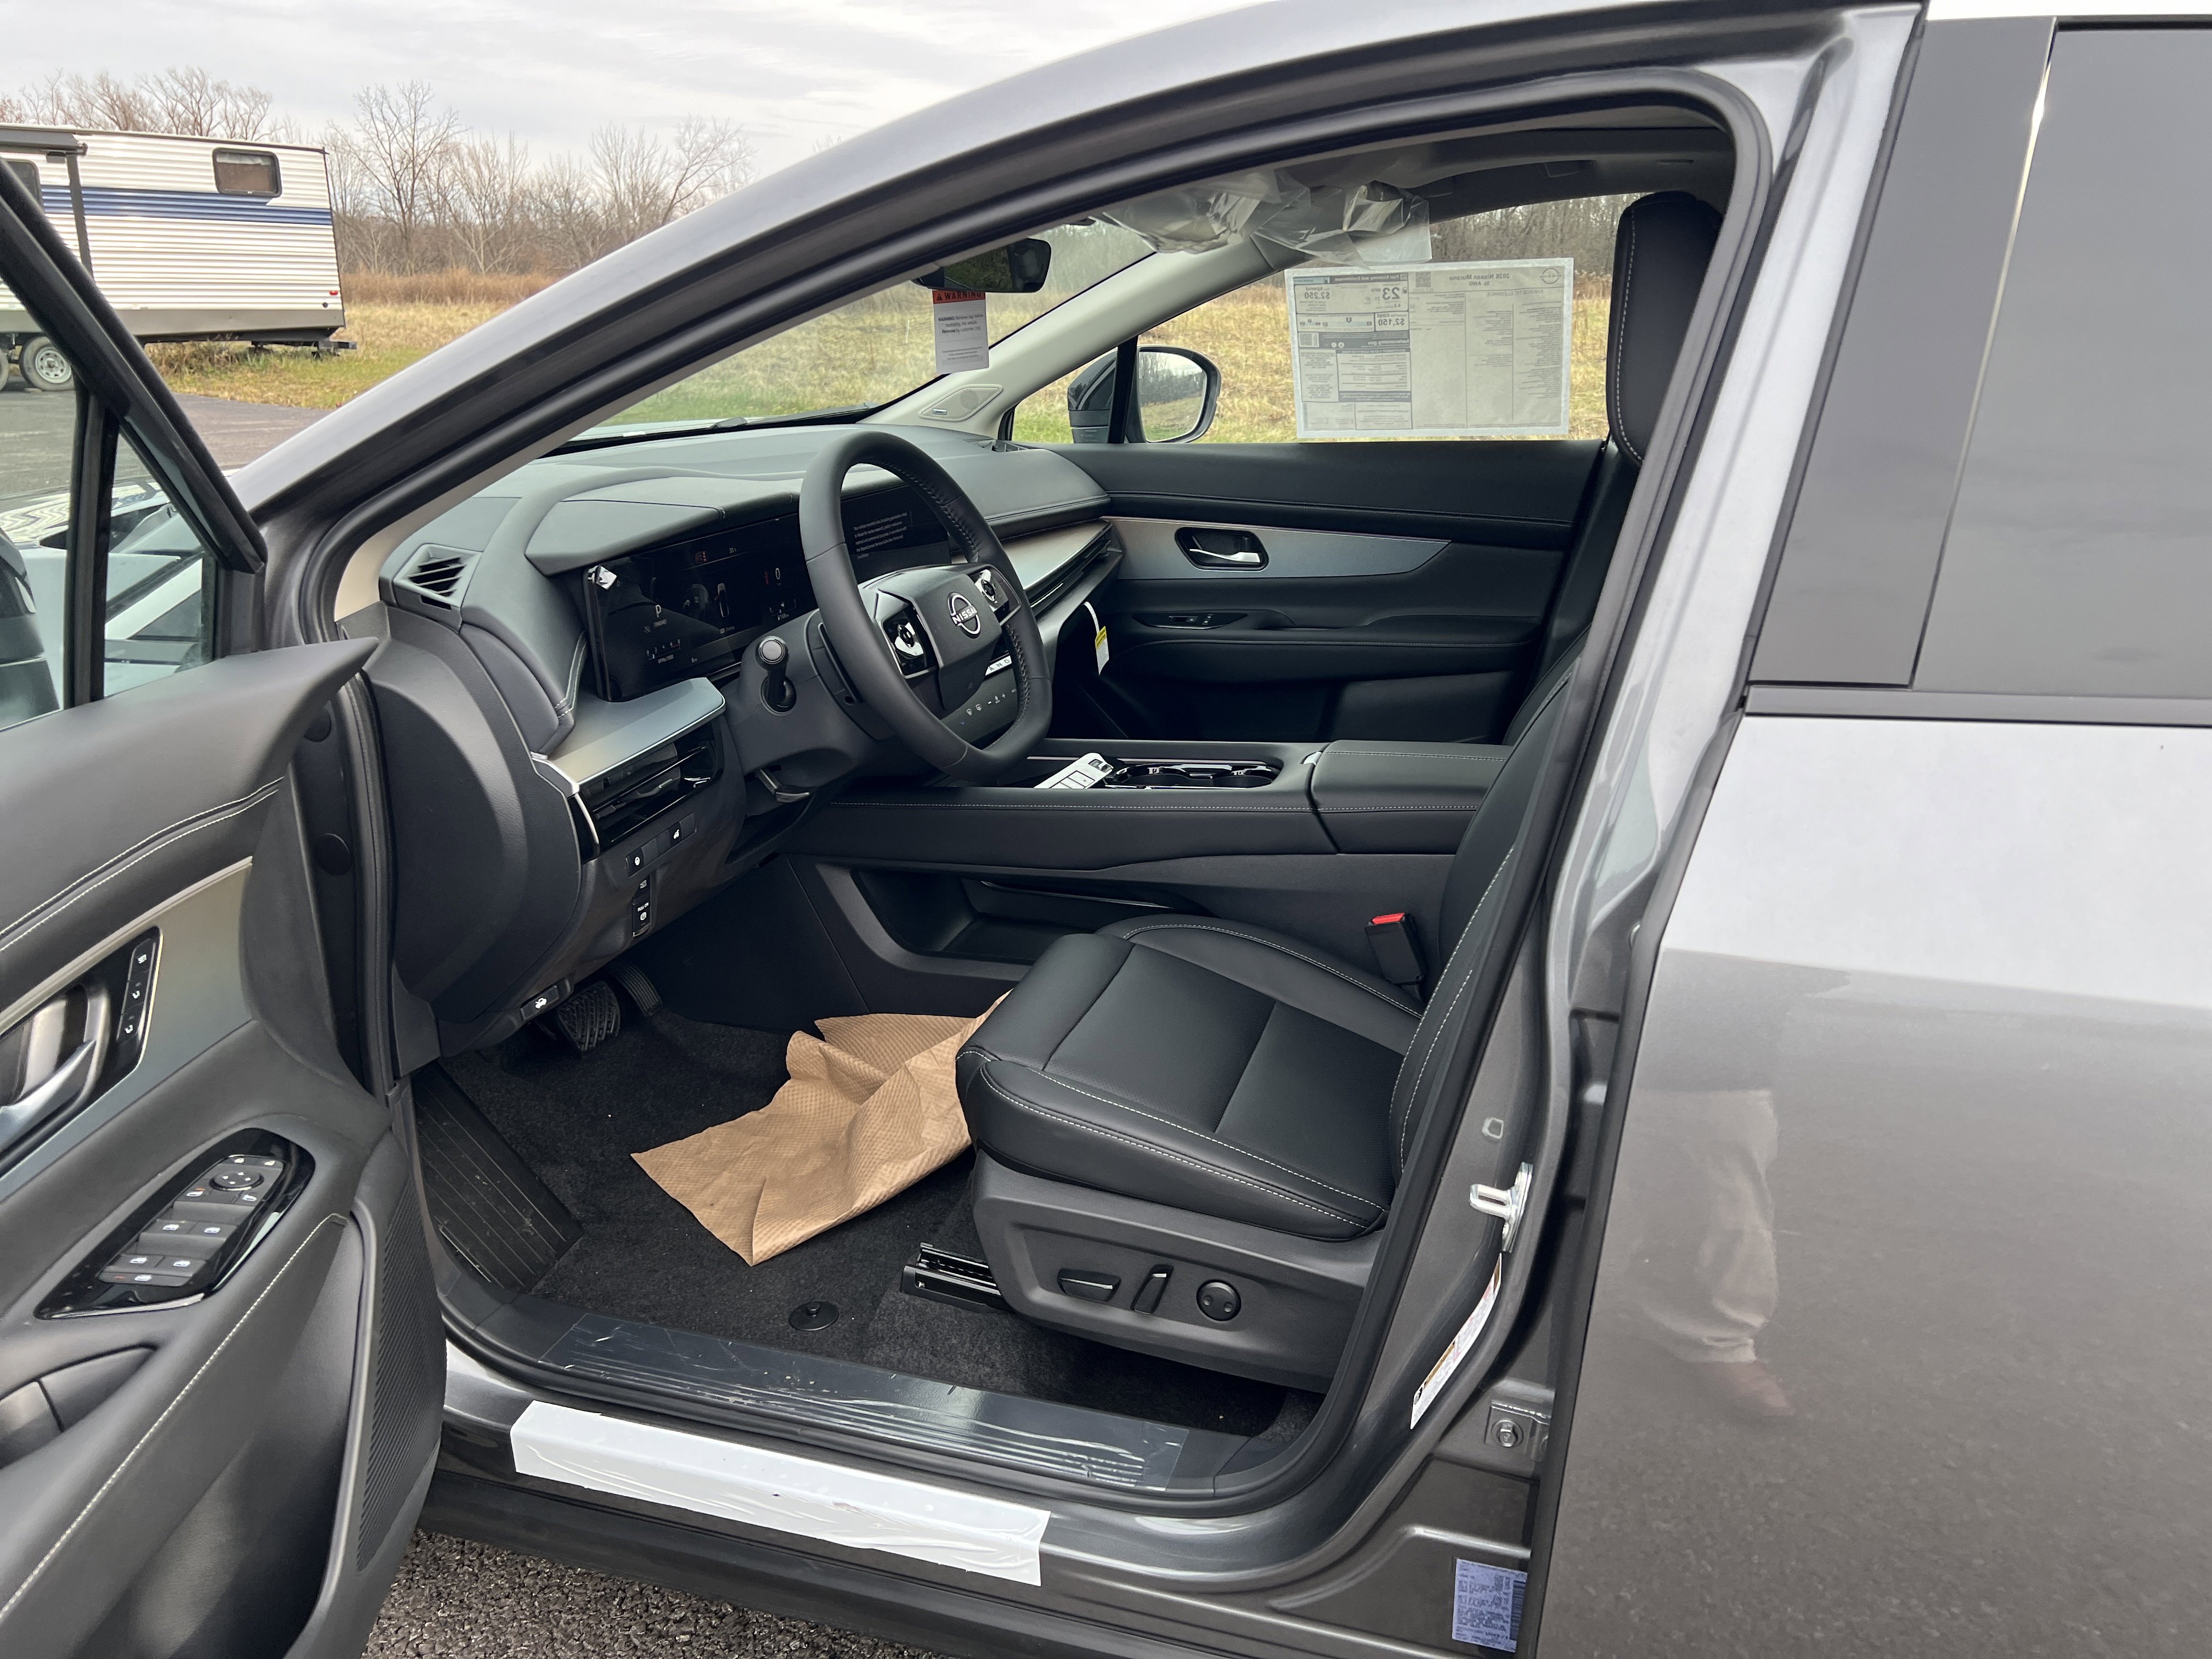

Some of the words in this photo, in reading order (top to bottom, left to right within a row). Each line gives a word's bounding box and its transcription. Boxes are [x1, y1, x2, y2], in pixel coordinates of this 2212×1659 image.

[944, 291, 981, 301] WARNING
[775, 567, 781, 580] 0
[655, 605, 662, 618] P
[952, 606, 978, 625] NISSAN
